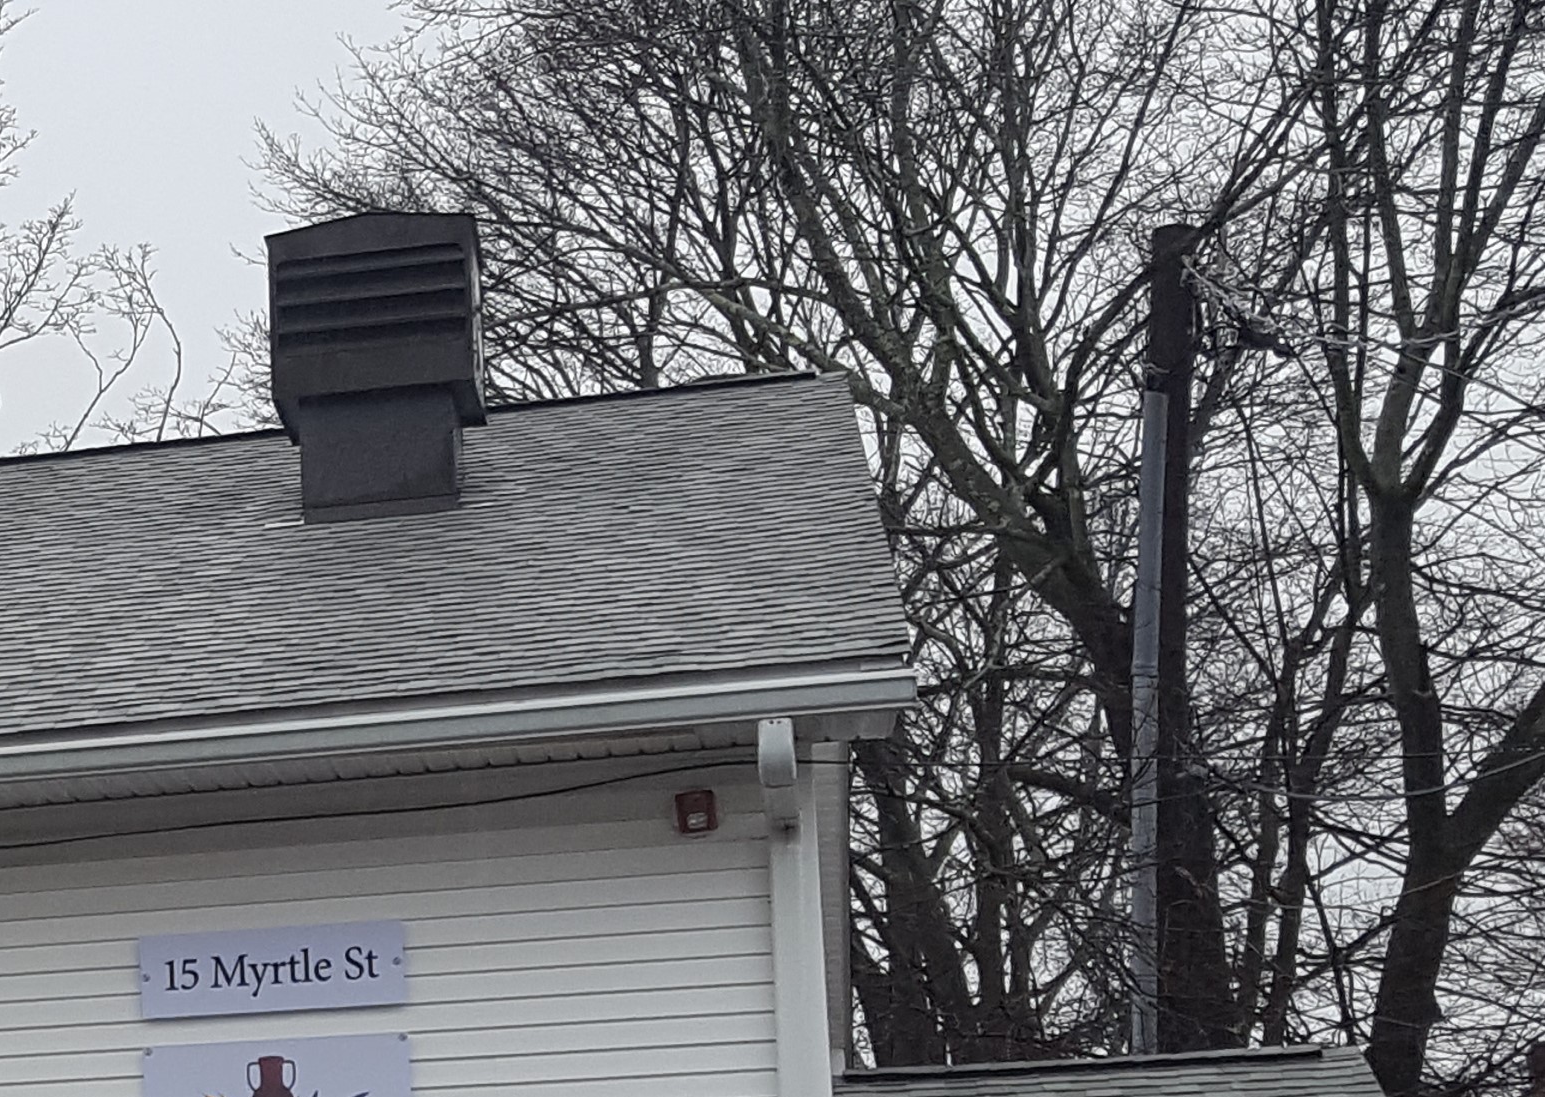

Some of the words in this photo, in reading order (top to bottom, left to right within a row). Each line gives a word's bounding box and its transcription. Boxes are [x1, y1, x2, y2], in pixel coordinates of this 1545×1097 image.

[165, 959, 199, 991] 15
[210, 948, 332, 997] Myrtle
[344, 946, 380, 980] St
